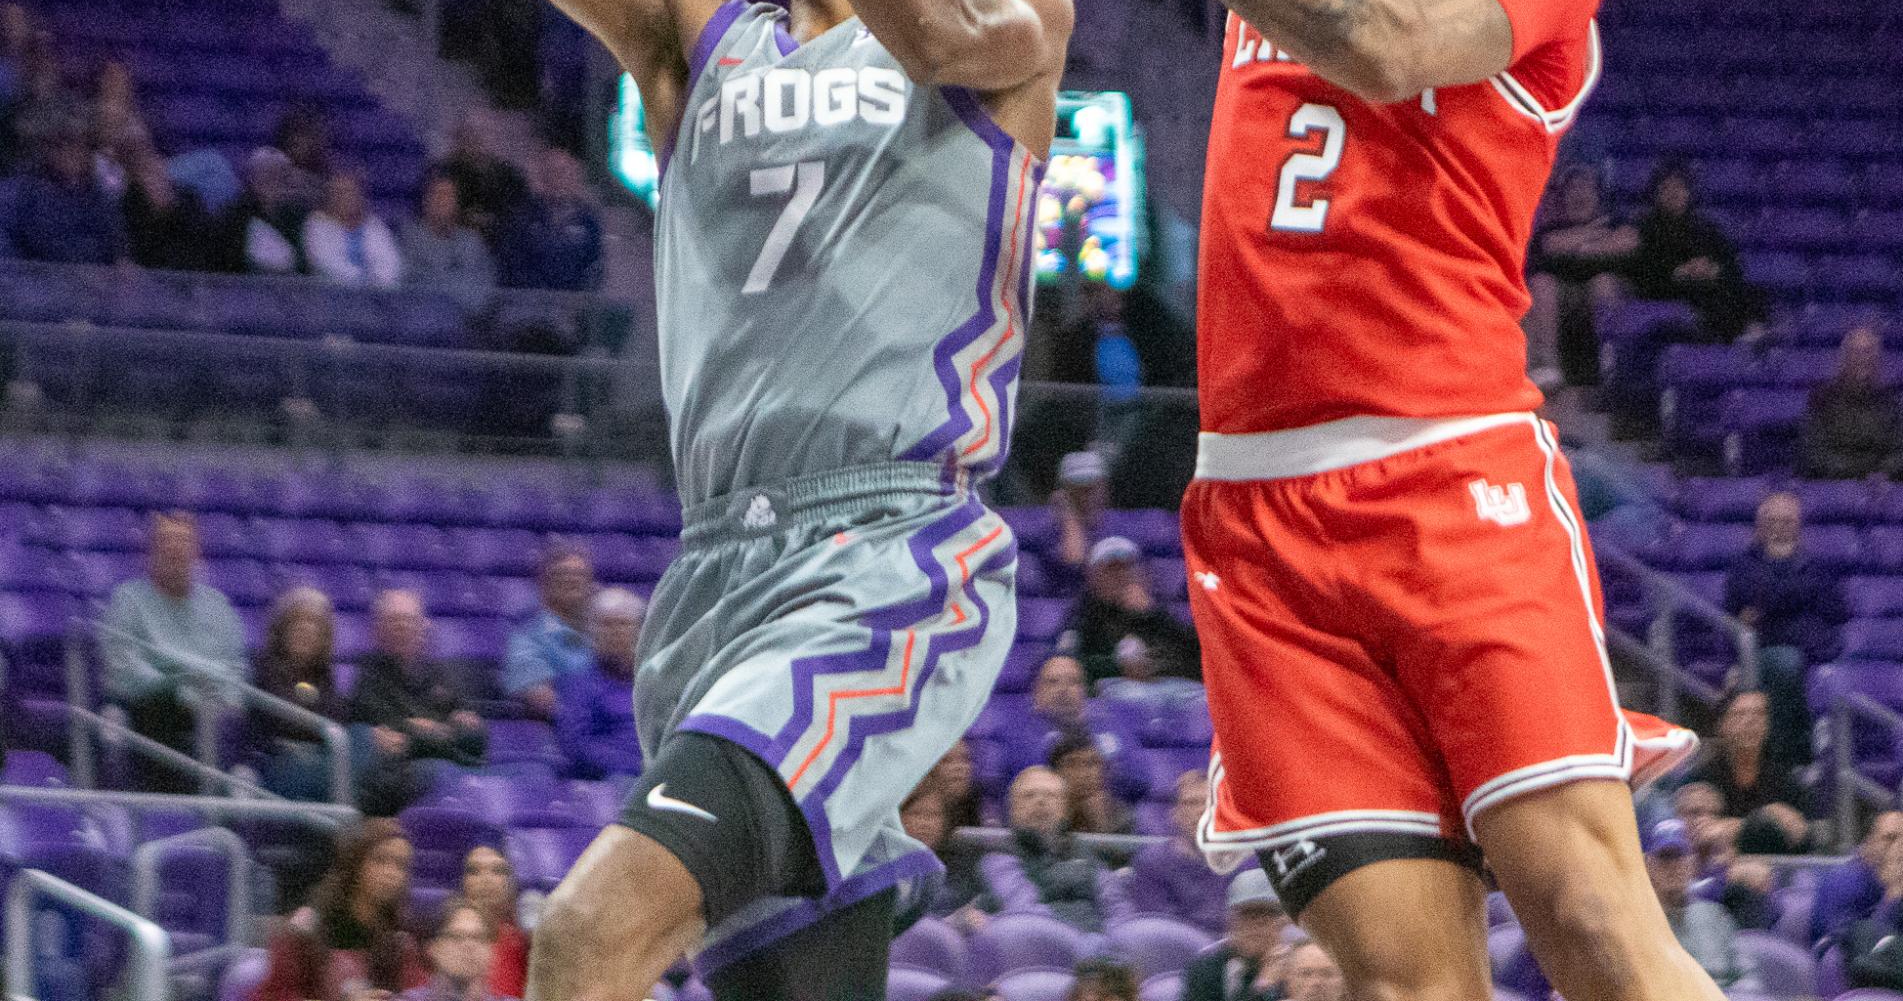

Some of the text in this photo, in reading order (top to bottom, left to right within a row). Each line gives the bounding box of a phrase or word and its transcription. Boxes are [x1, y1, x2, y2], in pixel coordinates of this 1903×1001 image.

[691, 66, 905, 164] FROGS
[1270, 103, 1346, 232] 2
[741, 159, 826, 294] 7
[1468, 478, 1531, 527] LU
